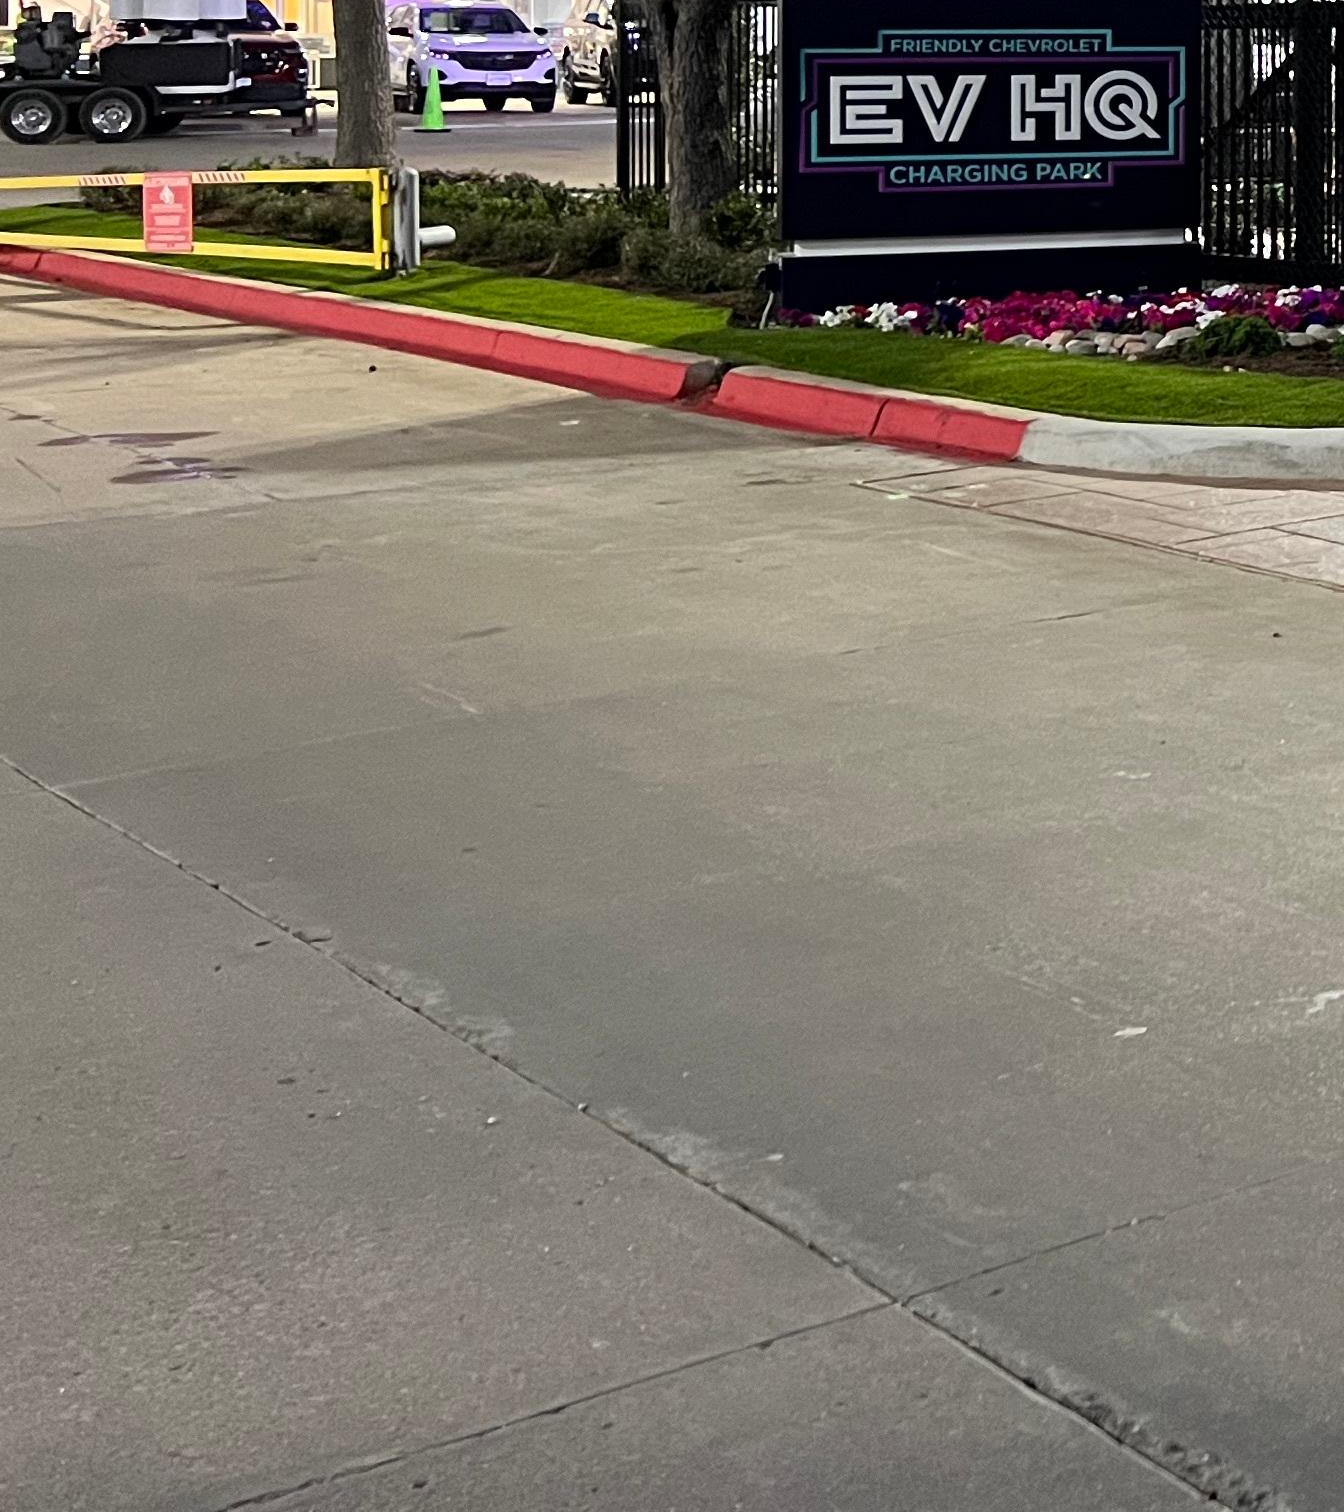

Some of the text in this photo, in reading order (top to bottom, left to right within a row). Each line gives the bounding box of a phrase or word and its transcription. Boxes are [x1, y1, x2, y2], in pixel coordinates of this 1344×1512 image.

[890, 39, 1102, 53] FRIENDLY CHEVROLET
[830, 70, 1162, 144] EV HQ
[889, 162, 1103, 184] CHARGING PARK
